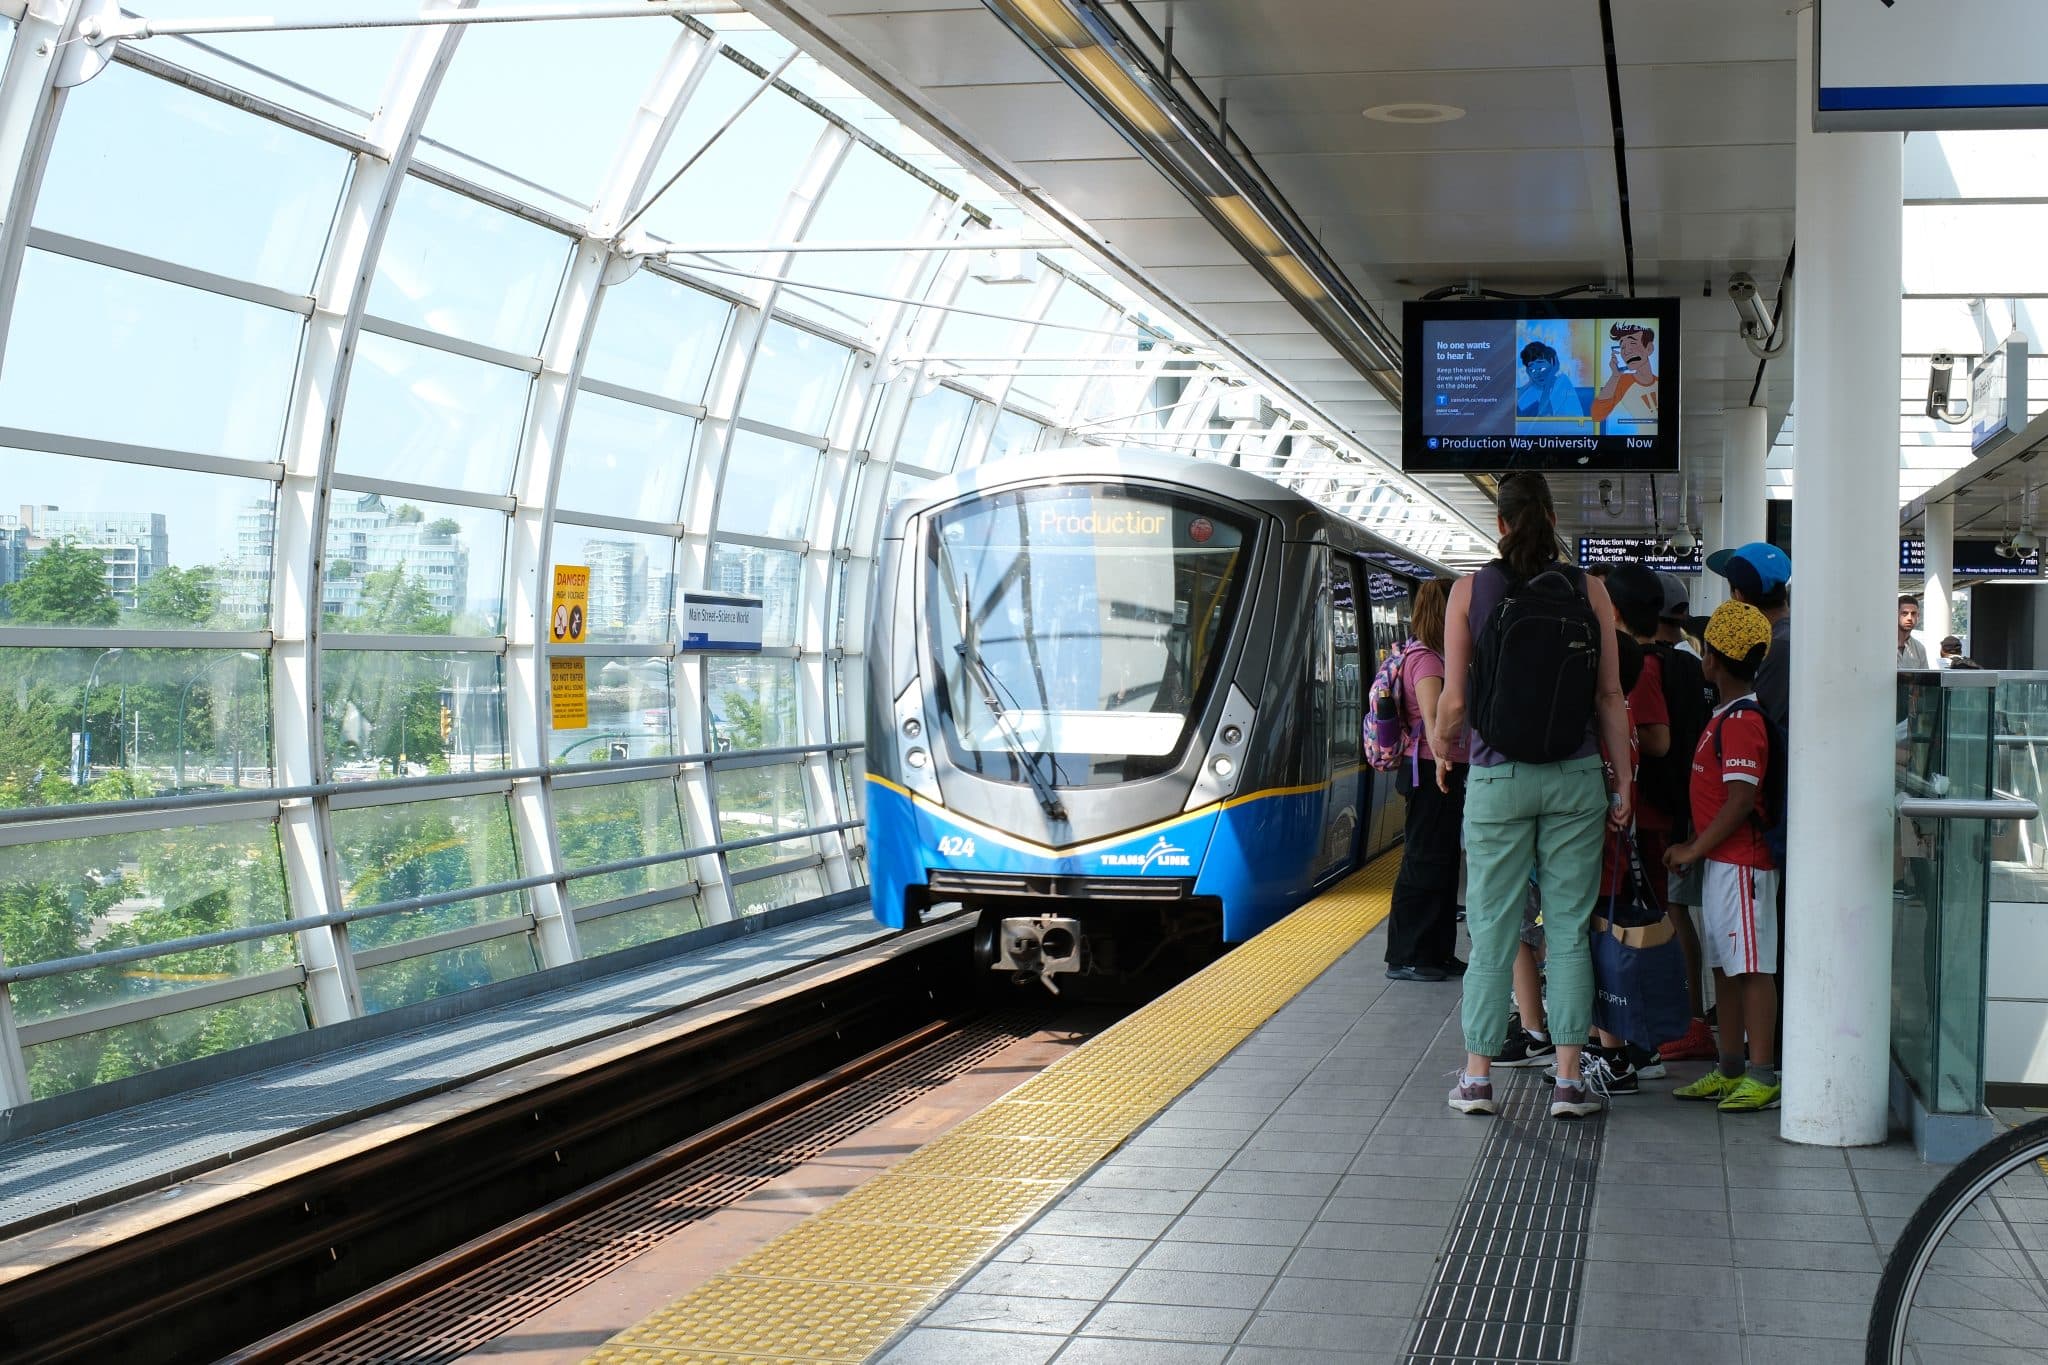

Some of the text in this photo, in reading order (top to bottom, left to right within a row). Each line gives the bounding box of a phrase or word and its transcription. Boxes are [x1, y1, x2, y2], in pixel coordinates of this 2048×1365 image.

[1436, 342, 1448, 350] No
[1466, 342, 1490, 350] wants
[1447, 352, 1464, 360] hear
[1466, 352, 1474, 360] it.
[1442, 437, 1599, 451] Production Way-University
[1626, 438, 1653, 448] Now
[1624, 539, 1640, 548] Way
[1589, 547, 1626, 555] King George
[1624, 555, 1638, 564] Way
[1644, 555, 1678, 564] University
[556, 573, 586, 586] DANGER
[568, 591, 584, 600] VOLTAGE
[689, 608, 701, 620] Main
[736, 612, 750, 624] World
[1726, 758, 1758, 768] KOHLER
[938, 836, 976, 857] 424
[1728, 932, 1736, 958] 7
